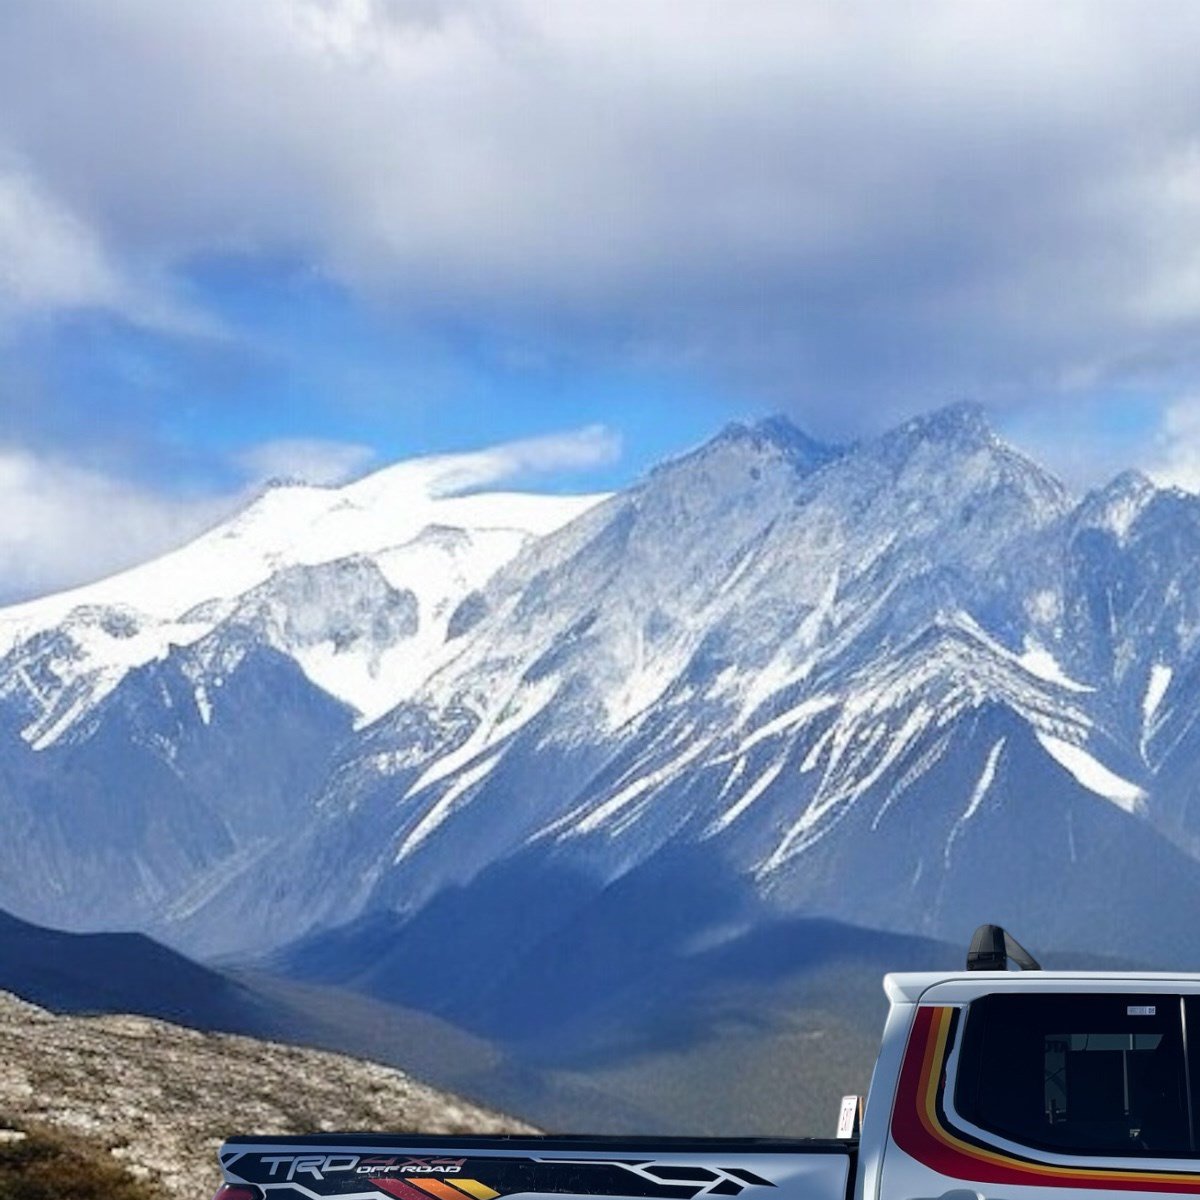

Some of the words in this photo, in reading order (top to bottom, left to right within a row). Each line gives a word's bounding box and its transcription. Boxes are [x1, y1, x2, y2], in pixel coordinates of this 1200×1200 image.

[260, 1155, 361, 1181] TRD
[356, 1165, 400, 1174] OFF
[400, 1165, 462, 1173] ROAD
